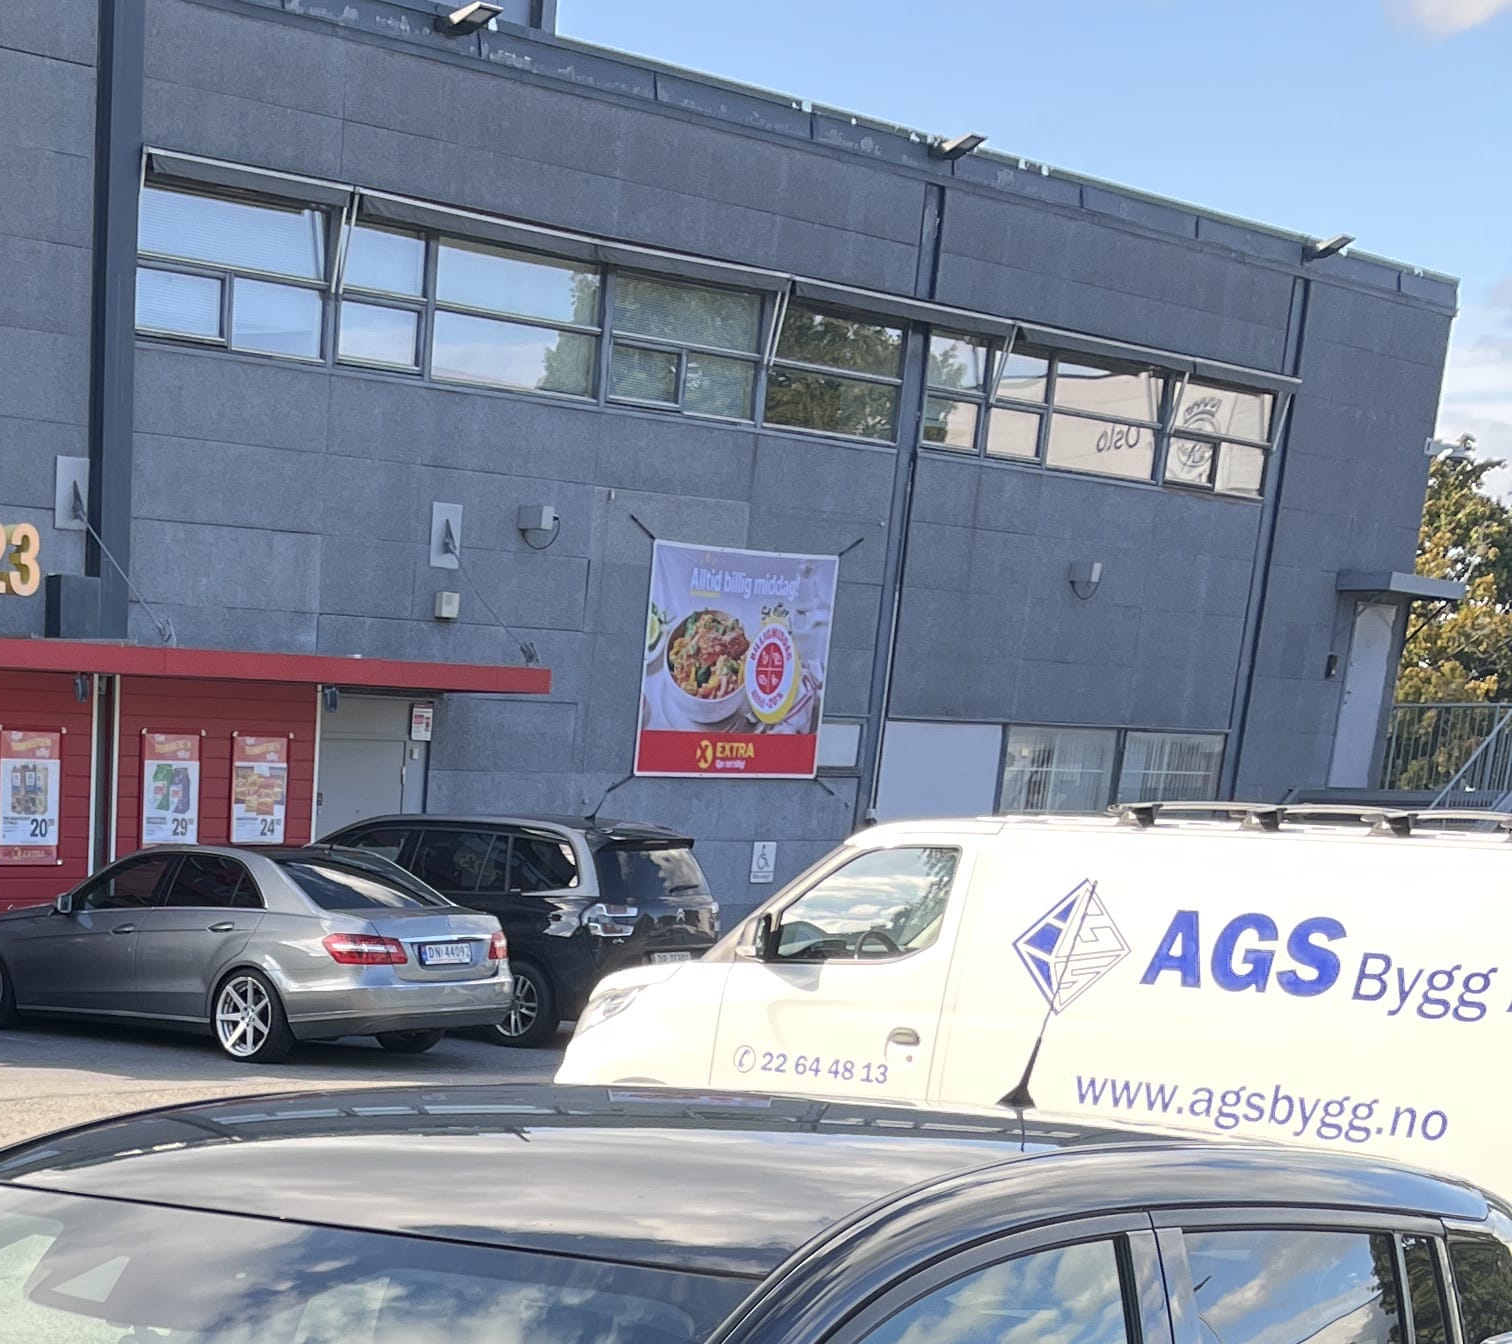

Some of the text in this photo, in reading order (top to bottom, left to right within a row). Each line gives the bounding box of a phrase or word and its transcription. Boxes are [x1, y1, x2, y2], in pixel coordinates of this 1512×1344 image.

[691, 568, 801, 600] Alltid billig middag!
[716, 742, 755, 758] EXTRA
[30, 818, 47, 837] 20
[172, 818, 187, 836] 29
[260, 819, 275, 836] 24
[1139, 909, 1498, 1022] AGS Bygg
[760, 1052, 888, 1084] 22 64 48 13
[1076, 1075, 1448, 1143] www.agsbygg.no
